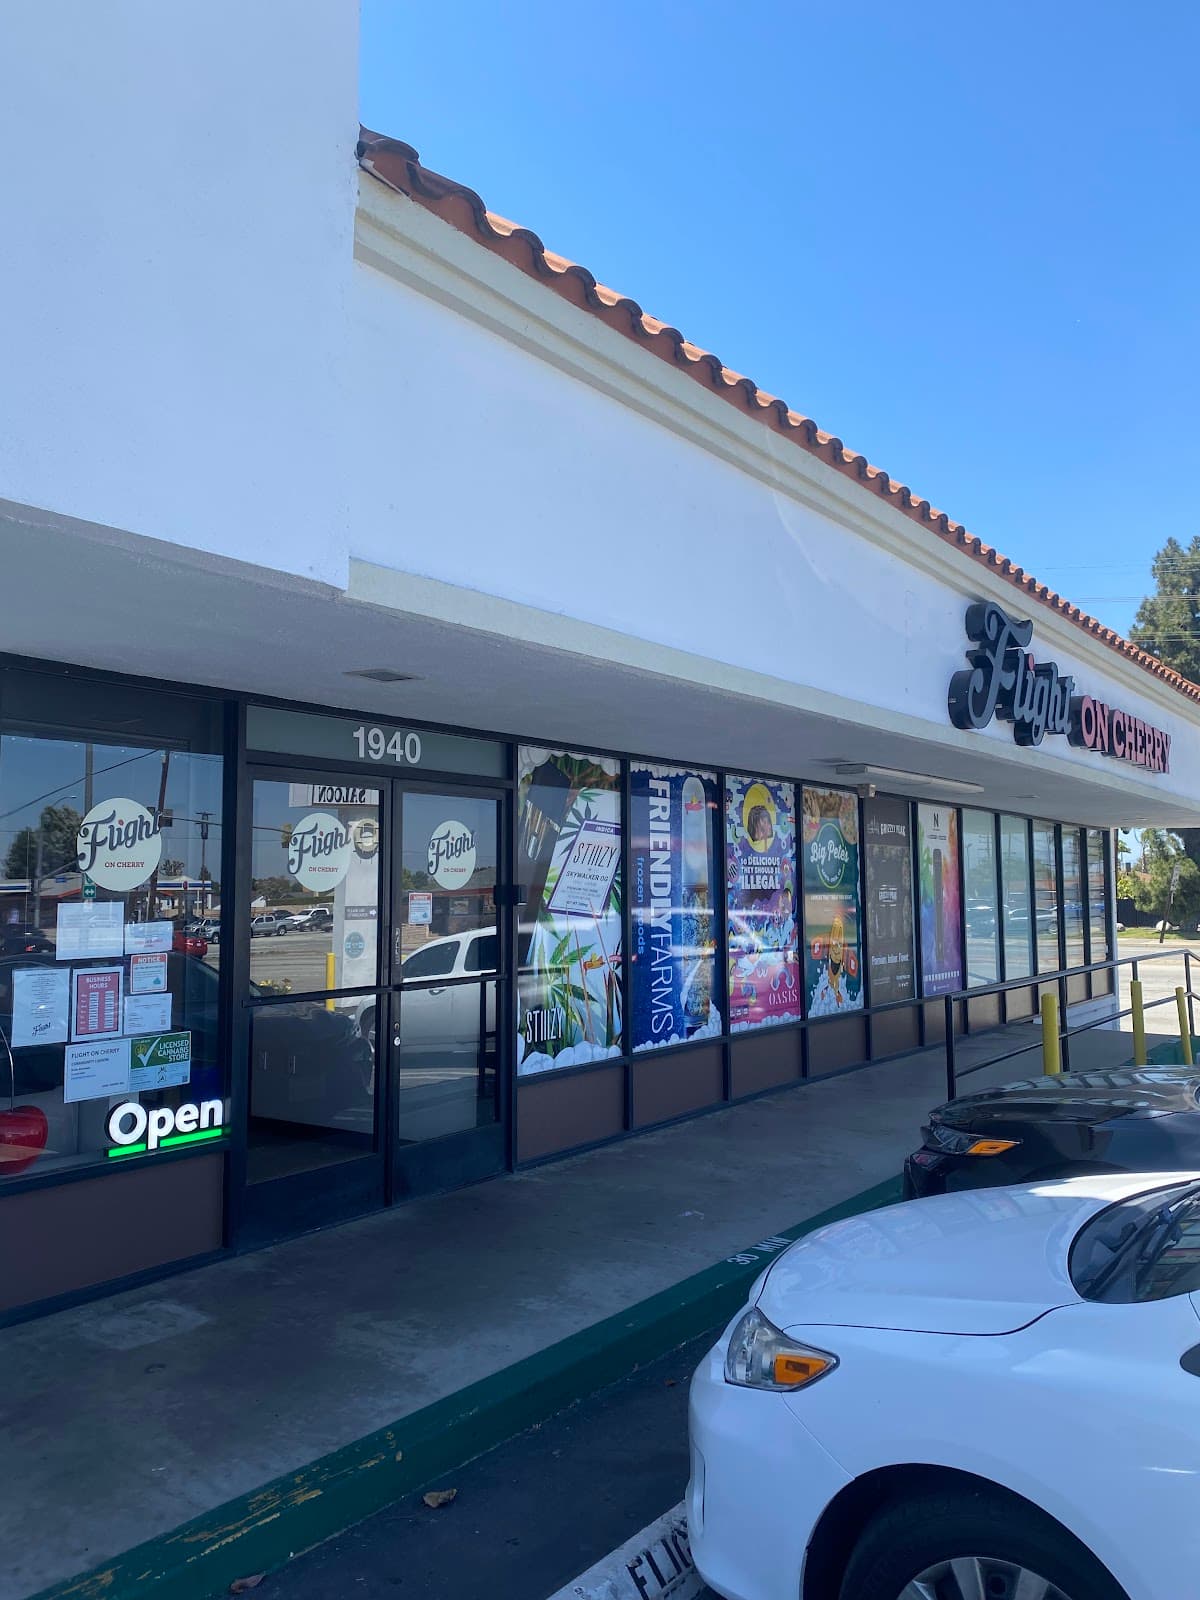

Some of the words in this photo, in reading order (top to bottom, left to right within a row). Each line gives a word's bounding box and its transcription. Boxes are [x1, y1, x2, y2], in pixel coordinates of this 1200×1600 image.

[949, 601, 1076, 746] Flight
[352, 726, 422, 764] 1940
[1080, 695, 1110, 753] ON
[1112, 708, 1172, 775] CHERRY
[595, 825, 614, 833] INDICA
[78, 809, 161, 873] Flight
[287, 822, 352, 875] Flight
[427, 829, 476, 876] Flight
[747, 854, 780, 866] DELICIOUS
[810, 842, 827, 865] Big
[827, 840, 849, 863] Pete's
[566, 870, 600, 881] SKYWALKER
[741, 866, 754, 874] THEY
[637, 857, 645, 904] frozen
[741, 874, 781, 890] ILLEGAL
[768, 990, 798, 1006] OASIS
[71, 1051, 91, 1059] FLIGHT
[157, 1047, 190, 1057] CANNABIS
[159, 1040, 190, 1050] LICENSED
[168, 1053, 190, 1062] STORE
[108, 1099, 223, 1150] Open
[726, 1253, 760, 1265] 30
[751, 1236, 793, 1253] MIN
